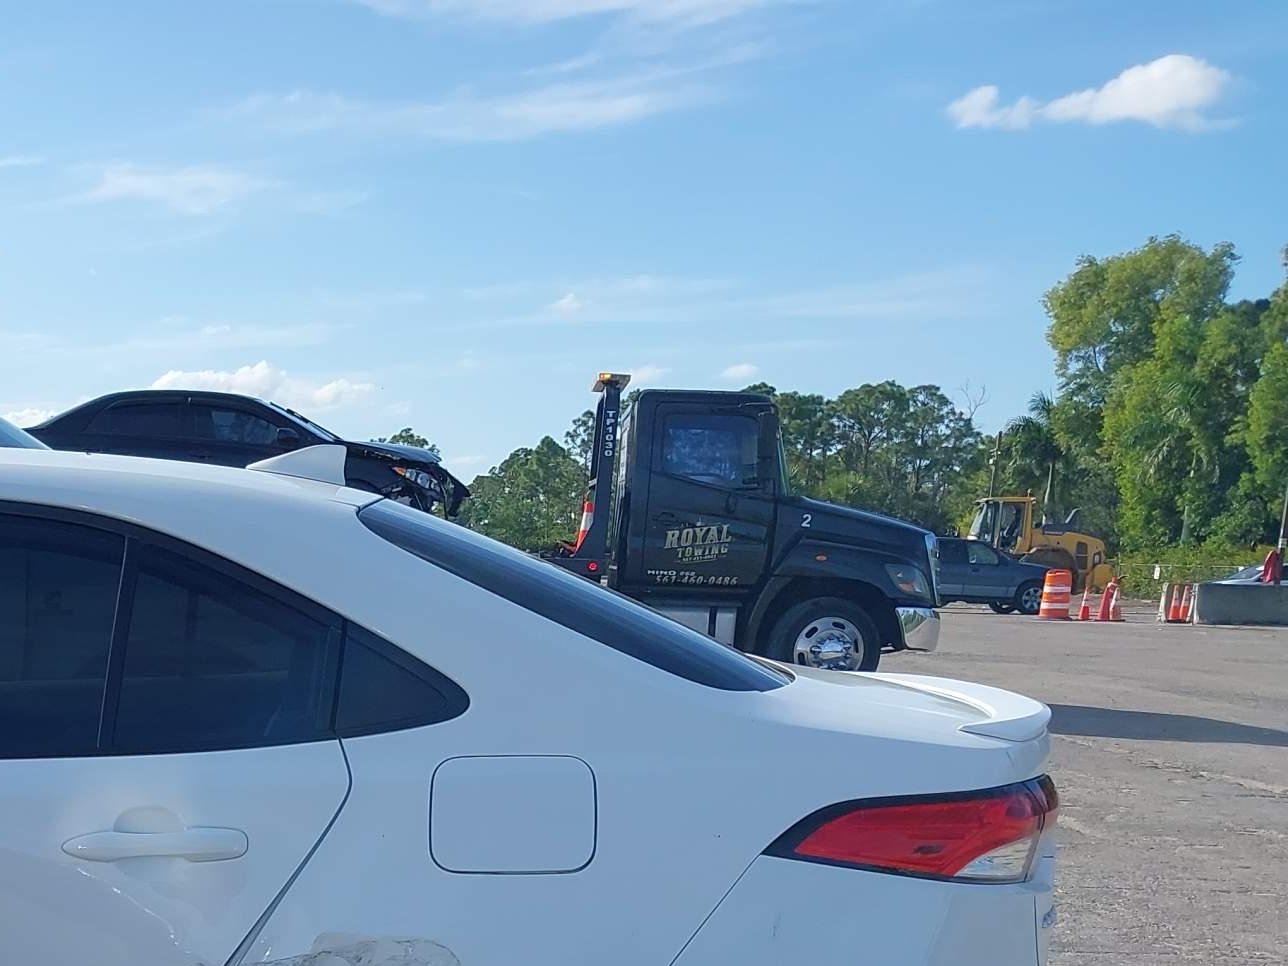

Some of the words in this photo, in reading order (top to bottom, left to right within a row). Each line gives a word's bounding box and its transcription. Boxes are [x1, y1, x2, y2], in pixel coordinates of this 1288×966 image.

[604, 410, 616, 457] TP1030
[801, 514, 812, 527] 2
[664, 524, 732, 548] ROYAL
[677, 543, 729, 558] TOWING
